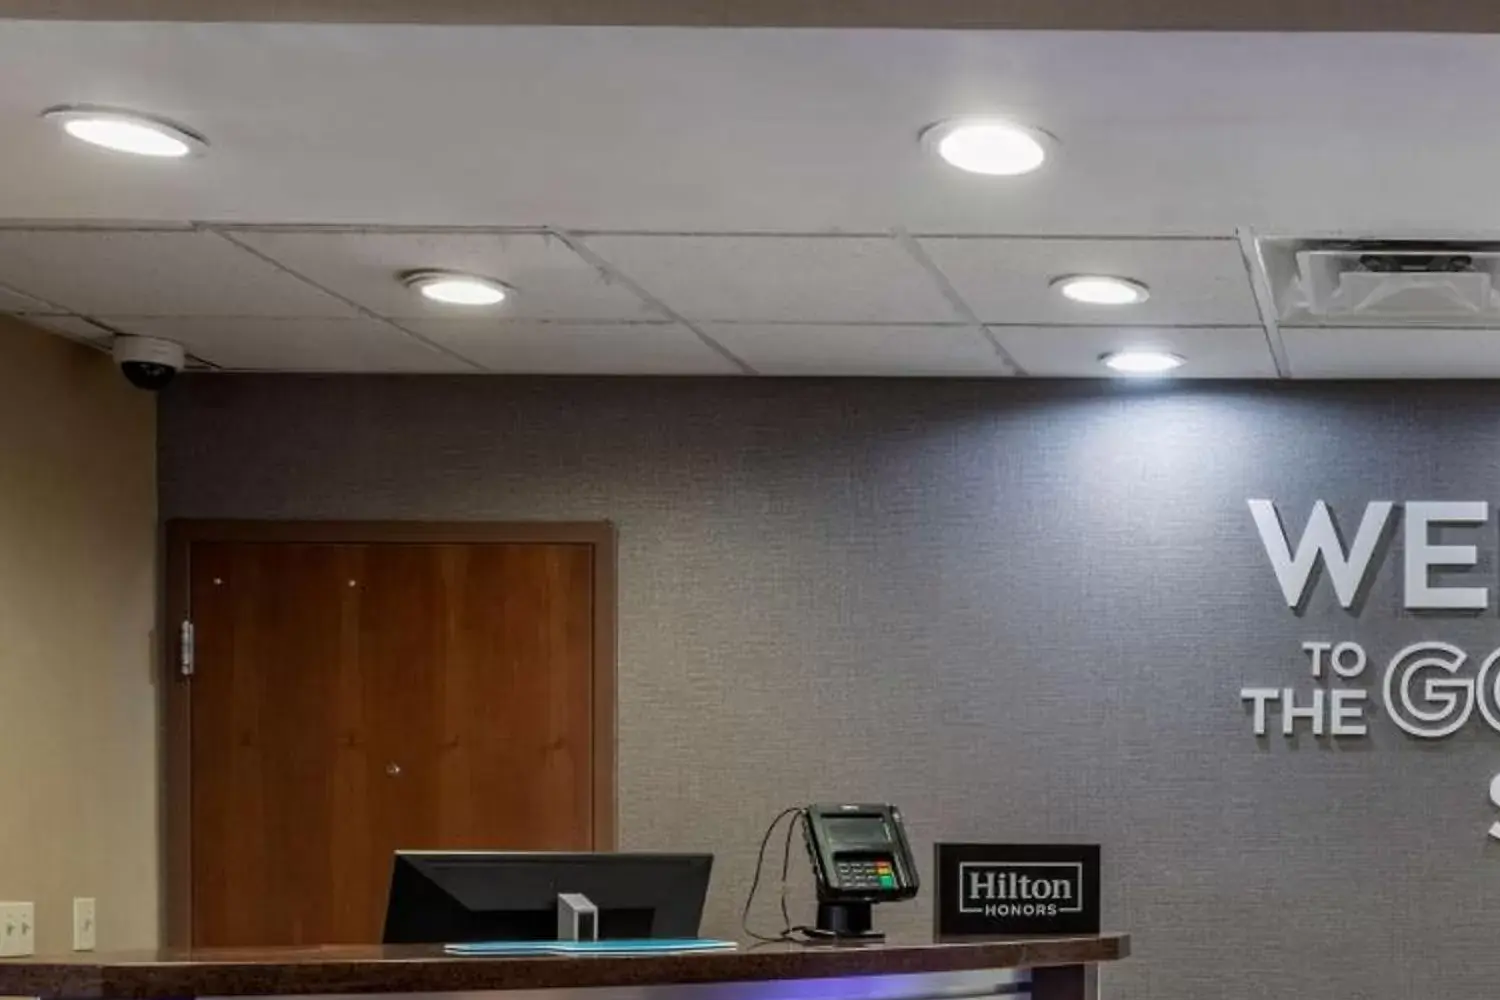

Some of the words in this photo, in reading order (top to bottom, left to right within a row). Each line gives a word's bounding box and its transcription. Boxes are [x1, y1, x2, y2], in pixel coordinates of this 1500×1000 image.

[1303, 641, 1366, 676] TO
[1241, 687, 1367, 735] THE
[969, 871, 1072, 899] Hilton
[984, 903, 1058, 917] HONORS
